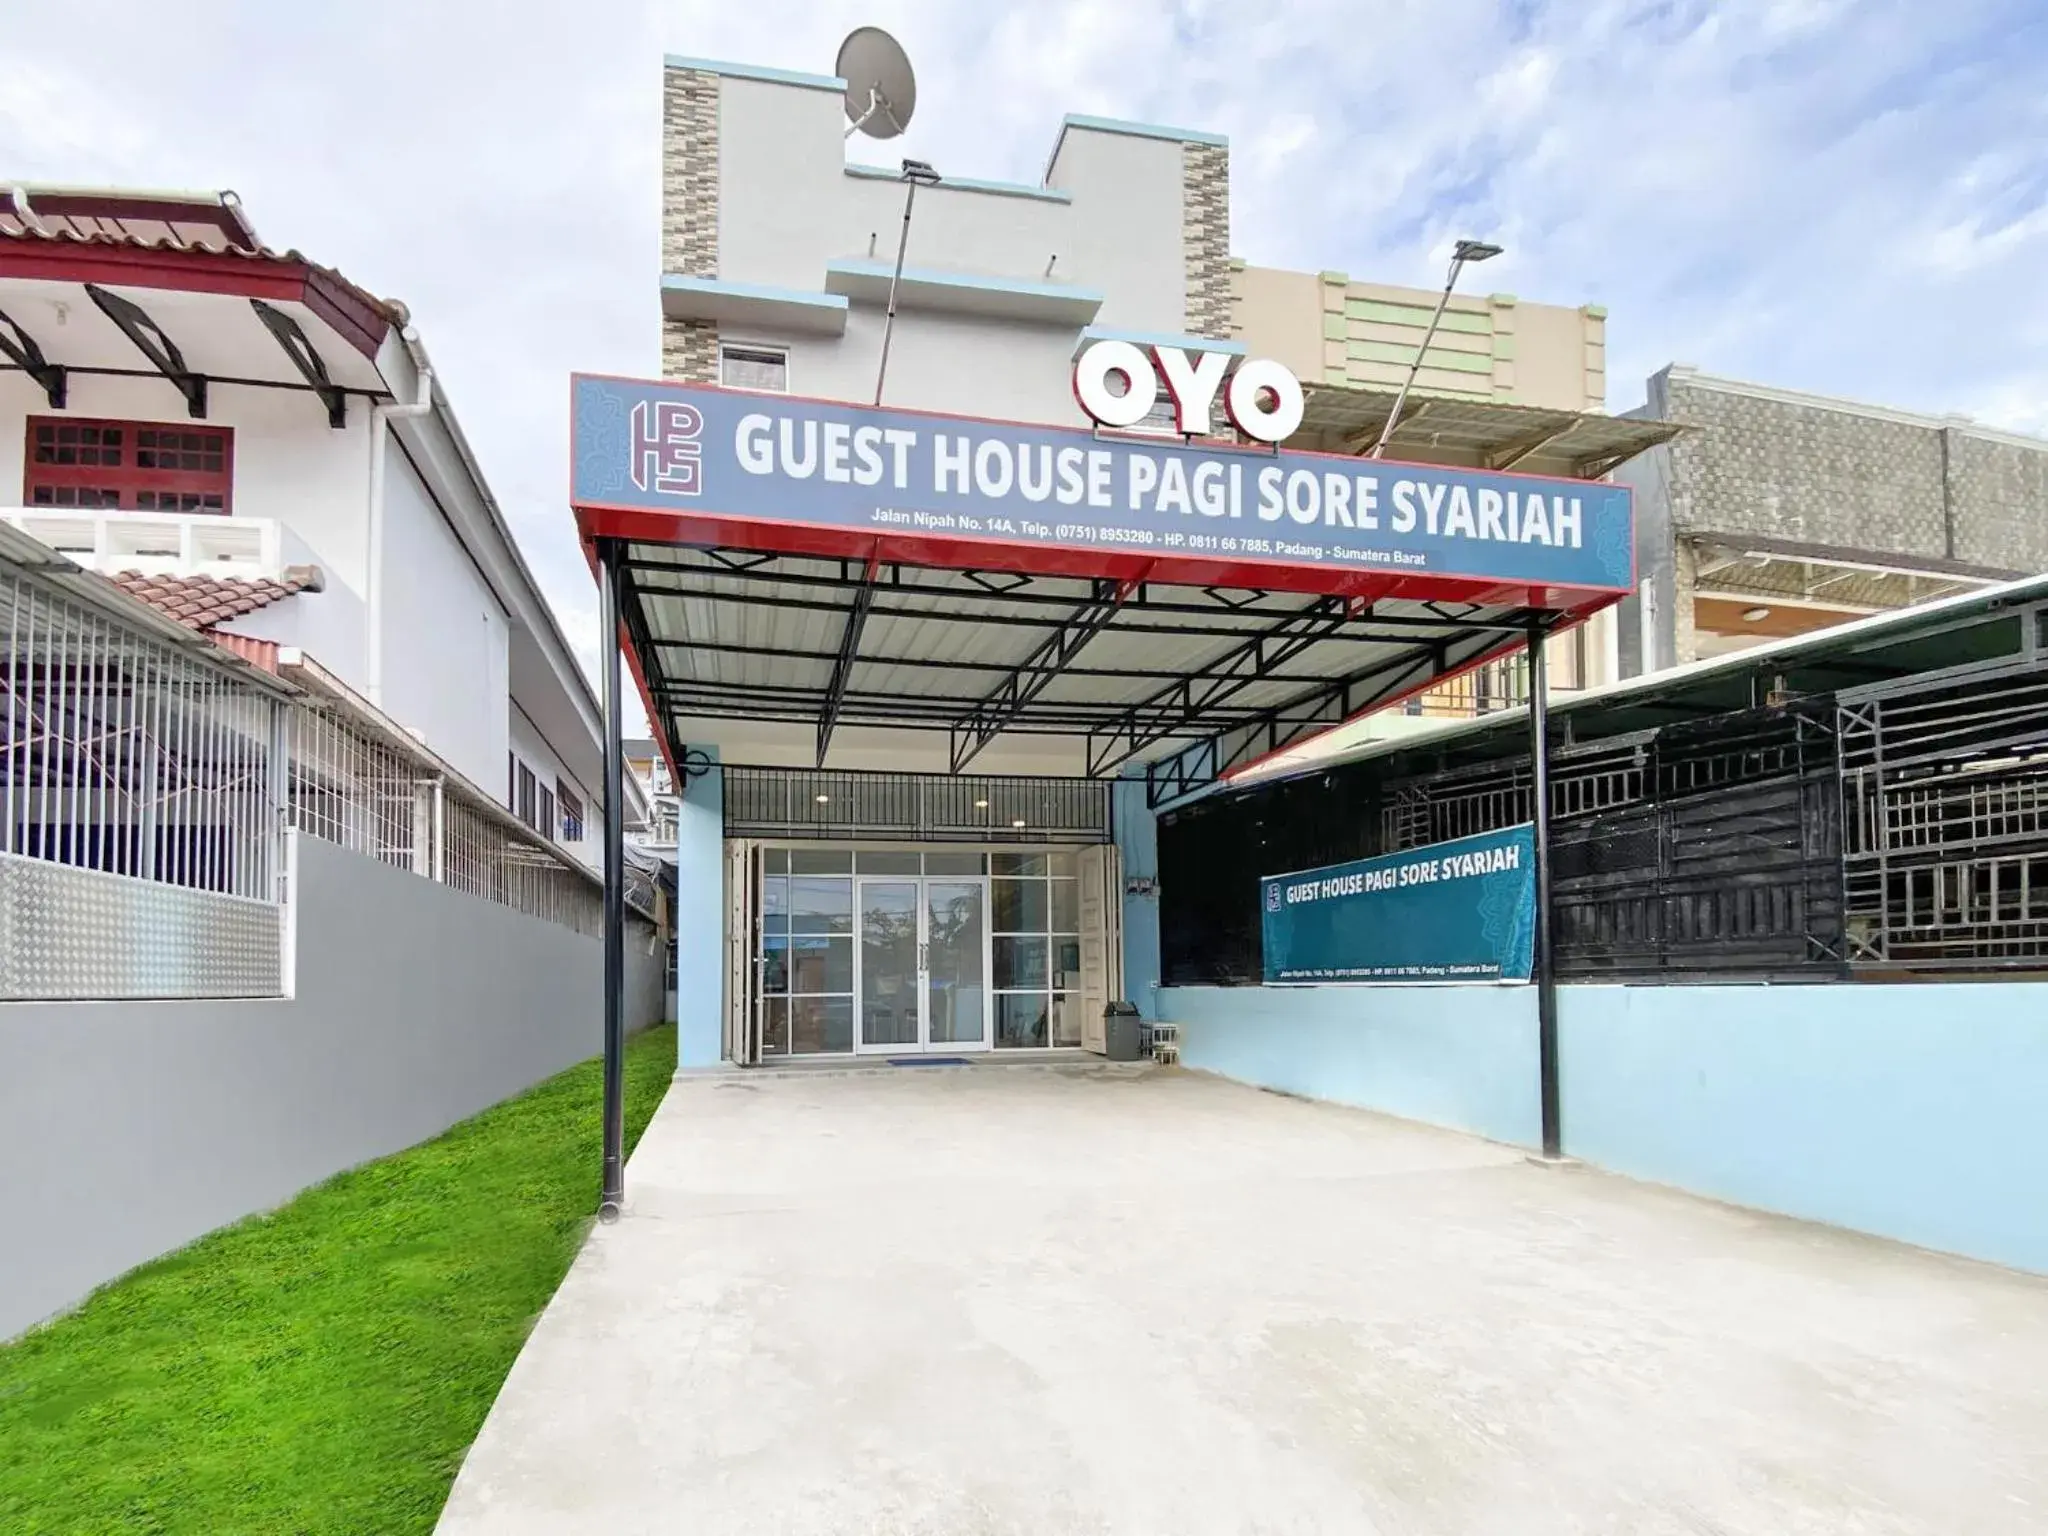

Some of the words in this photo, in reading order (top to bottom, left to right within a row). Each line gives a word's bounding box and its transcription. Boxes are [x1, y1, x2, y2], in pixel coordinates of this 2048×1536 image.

[1073, 339, 1305, 442] OYO
[735, 413, 916, 489] GUEST
[934, 433, 1111, 507] HOUSE
[1129, 453, 1242, 518] PAGI
[1257, 466, 1378, 530] SORE
[1391, 479, 1582, 549] SYARIAH
[871, 507, 910, 524] Jalan
[913, 511, 955, 529] Nipah
[958, 516, 982, 530] No.
[987, 519, 1017, 534] 14A,
[1021, 521, 1052, 538] Telp.
[1056, 524, 1096, 543] (0751)
[1099, 527, 1153, 544] 8953280
[1164, 531, 1186, 546] HP.
[1189, 533, 1217, 549] 0811
[1221, 538, 1237, 550] 66
[1240, 539, 1273, 555] 7885,
[1276, 543, 1322, 558] Padang
[1333, 546, 1391, 562] Sumatera
[1394, 551, 1426, 566] Barat
[1286, 884, 1321, 904] GUEST
[1322, 874, 1363, 899] HOUSE
[1365, 870, 1398, 892] PAGI
[1400, 860, 1439, 886] SORE
[1442, 844, 1520, 880] SYARIAH
